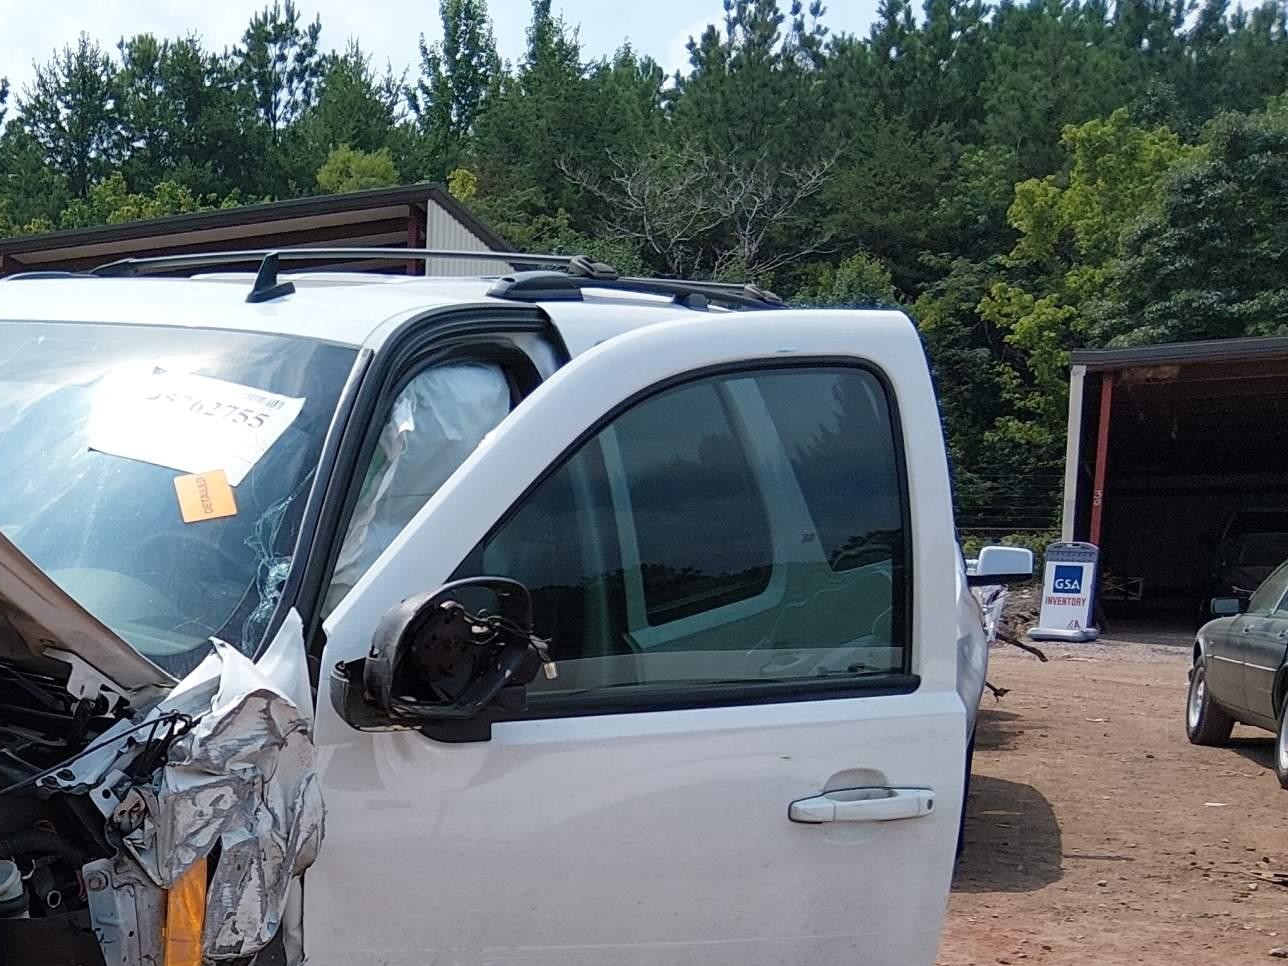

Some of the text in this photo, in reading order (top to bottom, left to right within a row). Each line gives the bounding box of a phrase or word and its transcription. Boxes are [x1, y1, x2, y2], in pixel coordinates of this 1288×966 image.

[196, 476, 214, 514] DETAILED
[1055, 578, 1080, 590] GSA
[1045, 596, 1087, 607] INVENTORY
